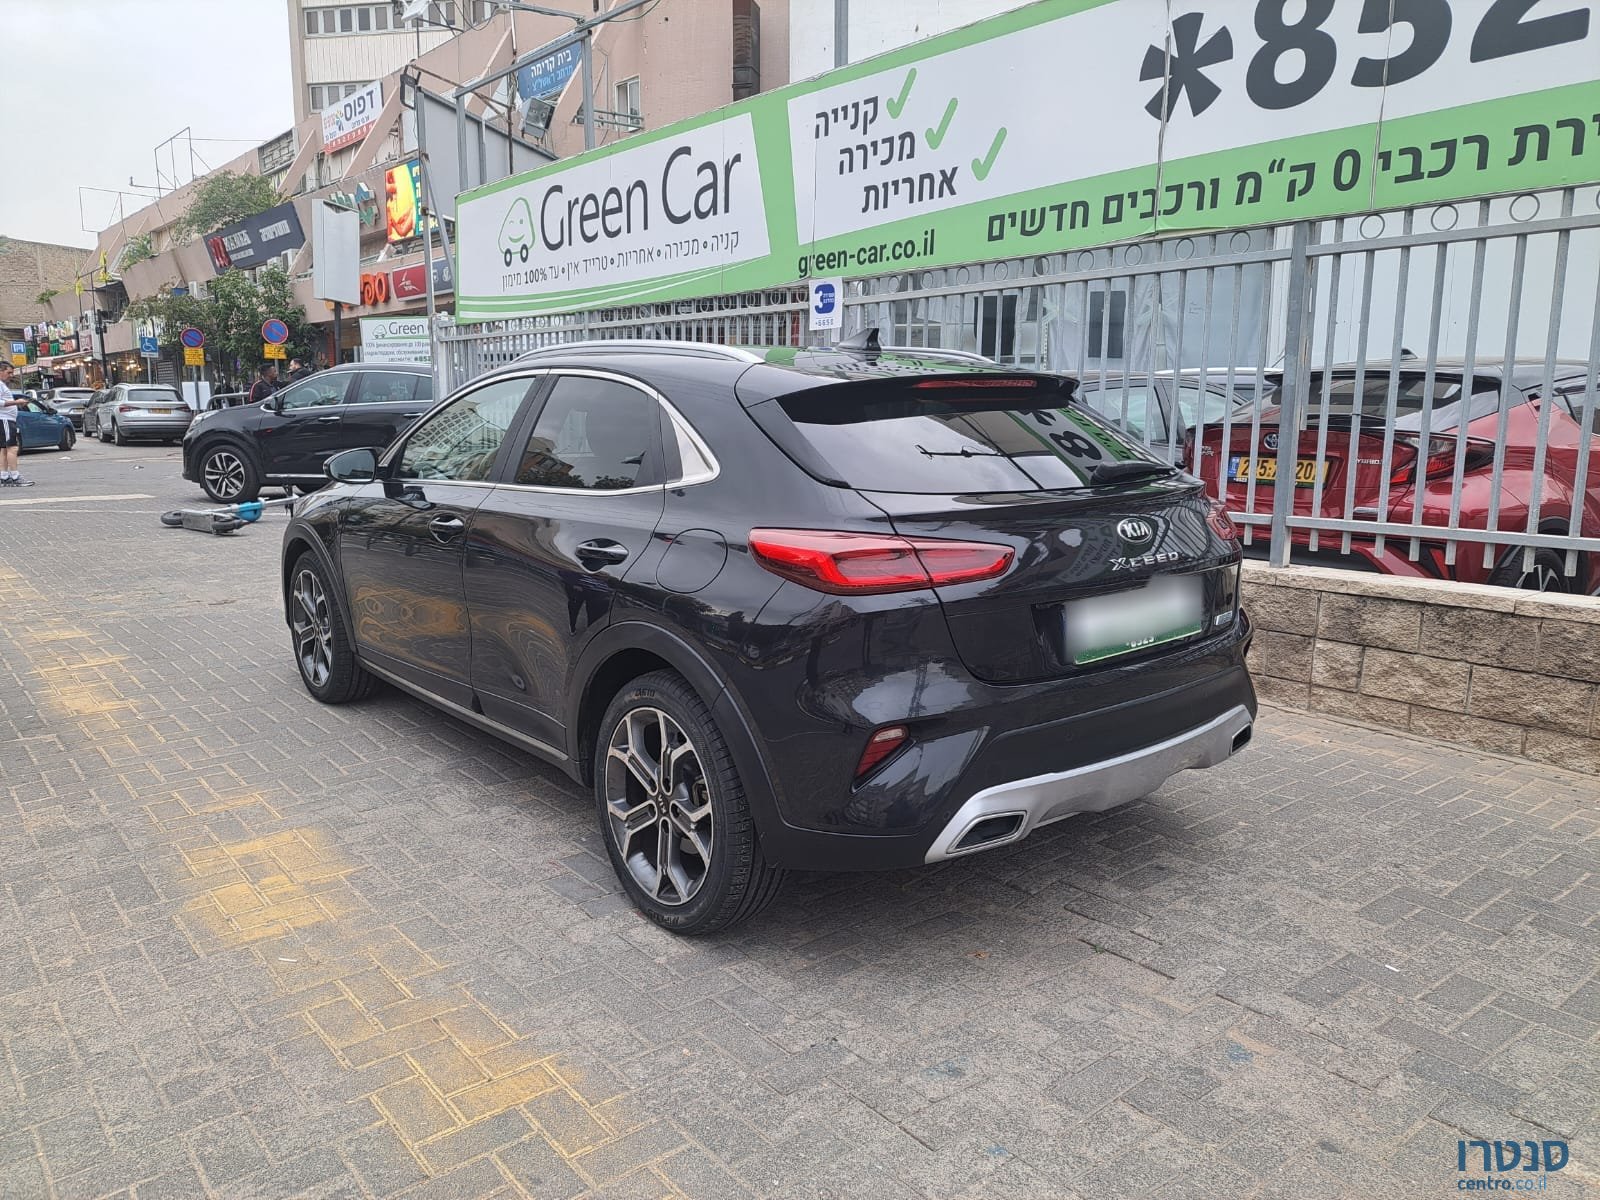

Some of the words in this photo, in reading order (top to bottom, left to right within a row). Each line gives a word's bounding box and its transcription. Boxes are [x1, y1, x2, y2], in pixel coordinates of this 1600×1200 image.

[344, 89, 374, 122] דפוס
[815, 95, 879, 139] קנייה
[838, 131, 916, 175] מכירה
[1378, 134, 1490, 184] רכבי
[540, 179, 649, 251] Green
[662, 145, 742, 224] Car
[861, 166, 959, 214] אחריות
[1102, 177, 1220, 226] ורכבים
[987, 200, 1090, 242] חדשים
[664, 238, 700, 260] מכירה
[711, 231, 739, 254] קניה
[582, 255, 608, 272] טרייד
[616, 247, 654, 269] אחריות
[798, 229, 935, 279] green-car.co.il
[502, 271, 522, 292] מימון
[524, 267, 548, 285] 100%
[548, 265, 560, 280] עד
[566, 261, 579, 282] אין
[389, 321, 424, 335] Green
[1121, 519, 1150, 539] KIA
[1109, 551, 1179, 571] XCEED
